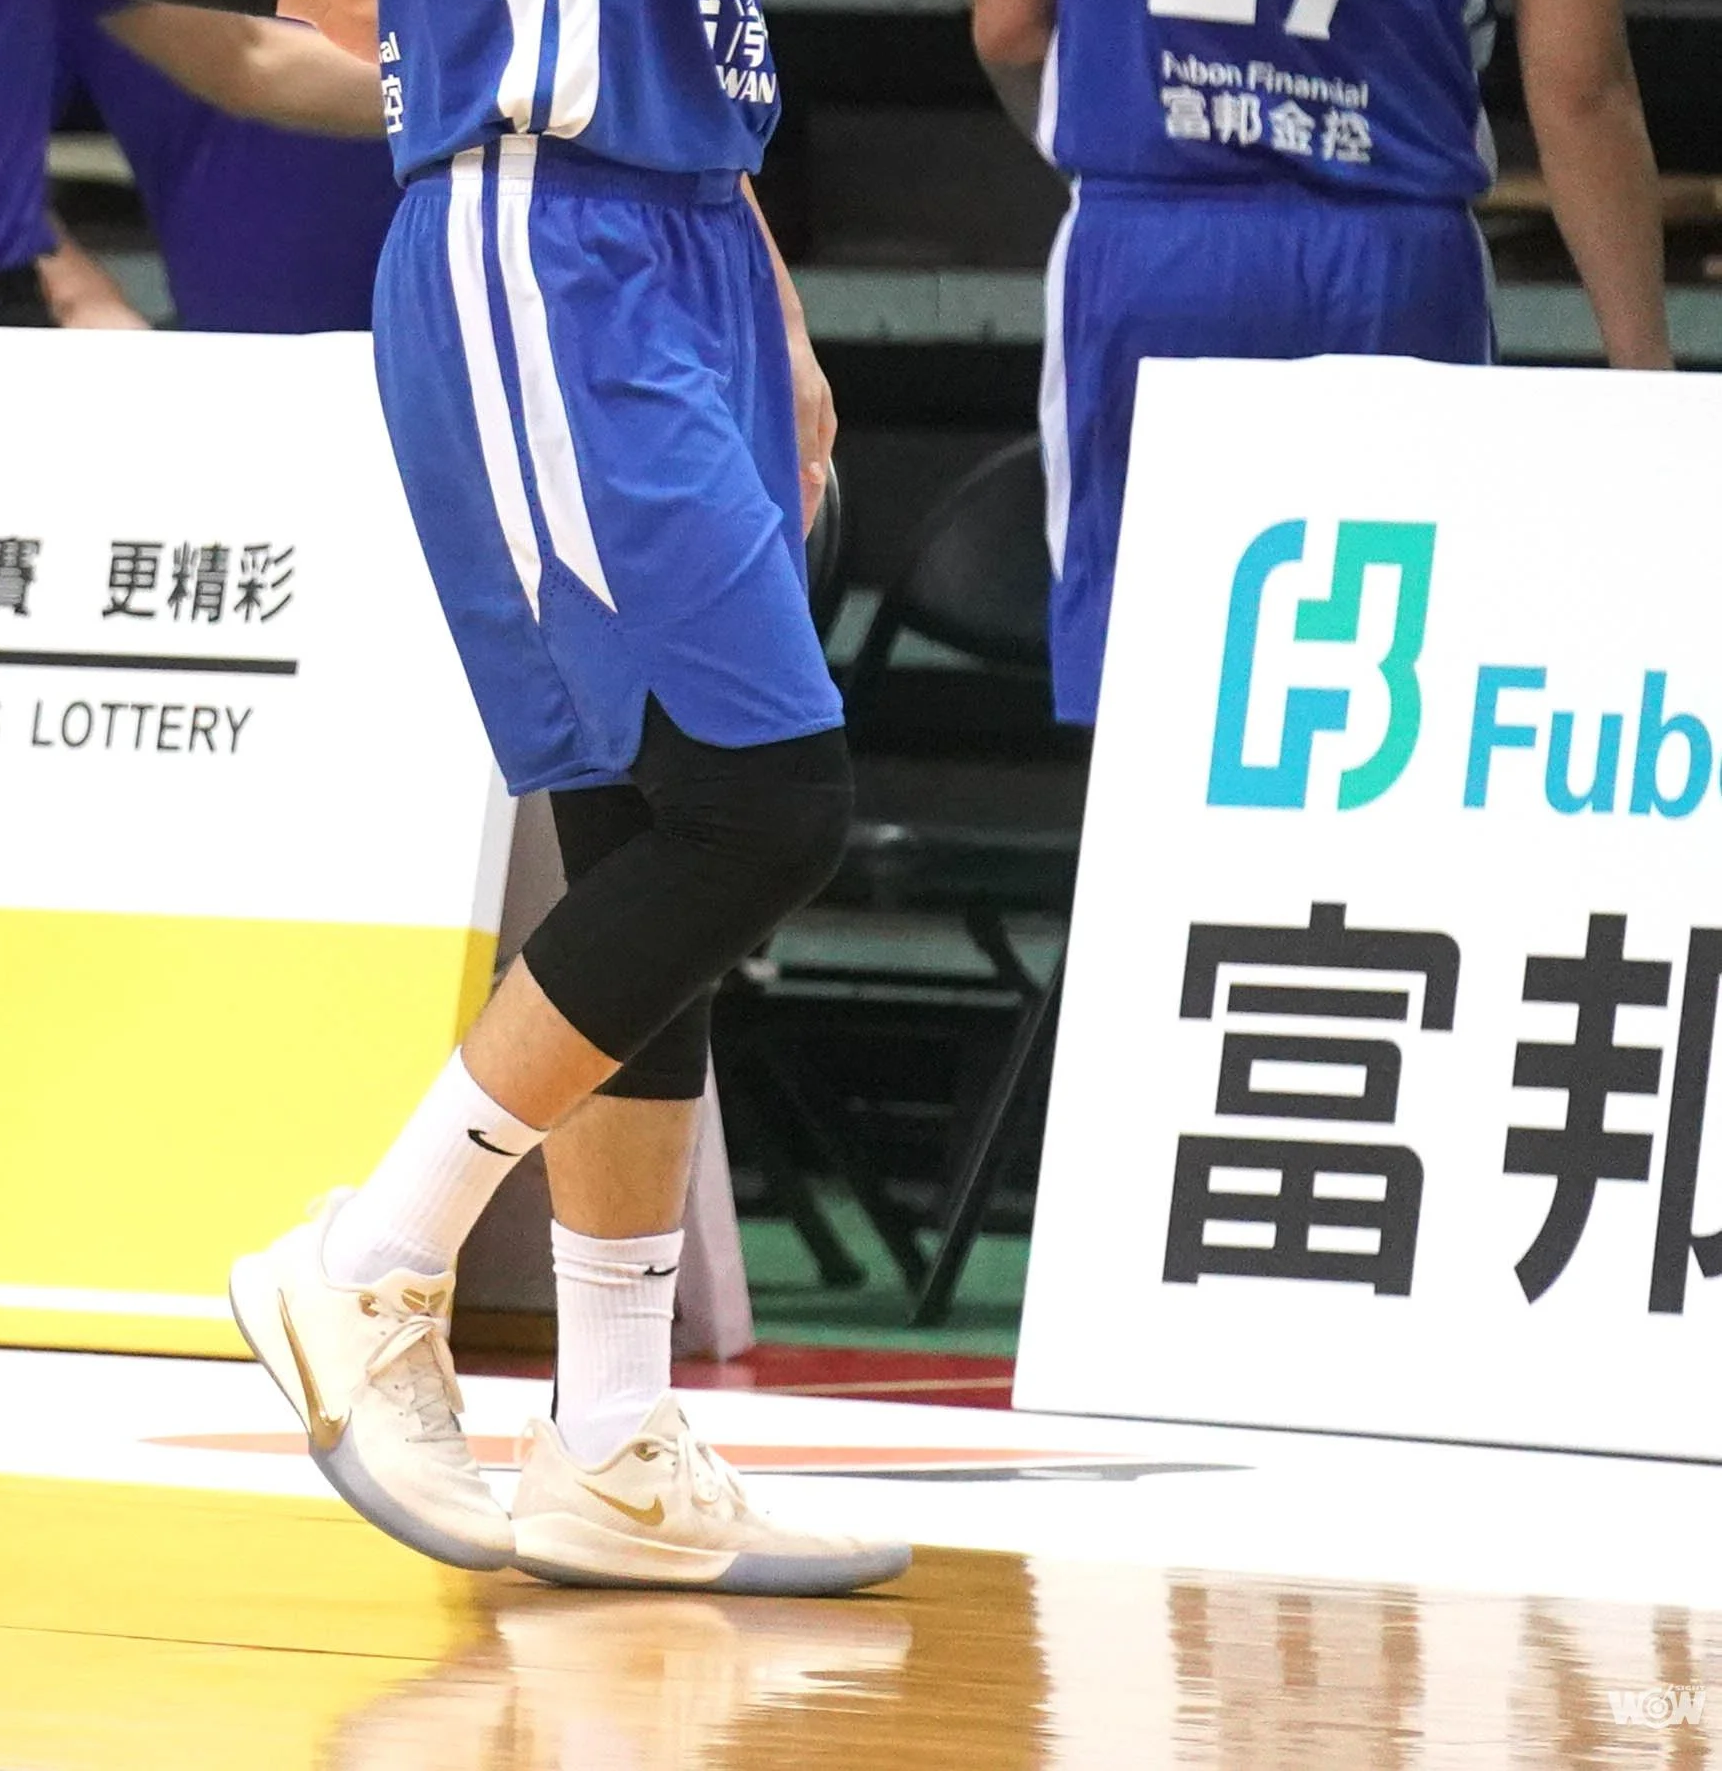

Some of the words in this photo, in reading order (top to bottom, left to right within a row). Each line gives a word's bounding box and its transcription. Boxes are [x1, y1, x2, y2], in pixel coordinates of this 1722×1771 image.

[1159, 83, 1373, 165] 富邦金控
[101, 539, 298, 625] 更精彩
[30, 698, 255, 755] LOTTERY
[1463, 663, 1722, 820] Fub
